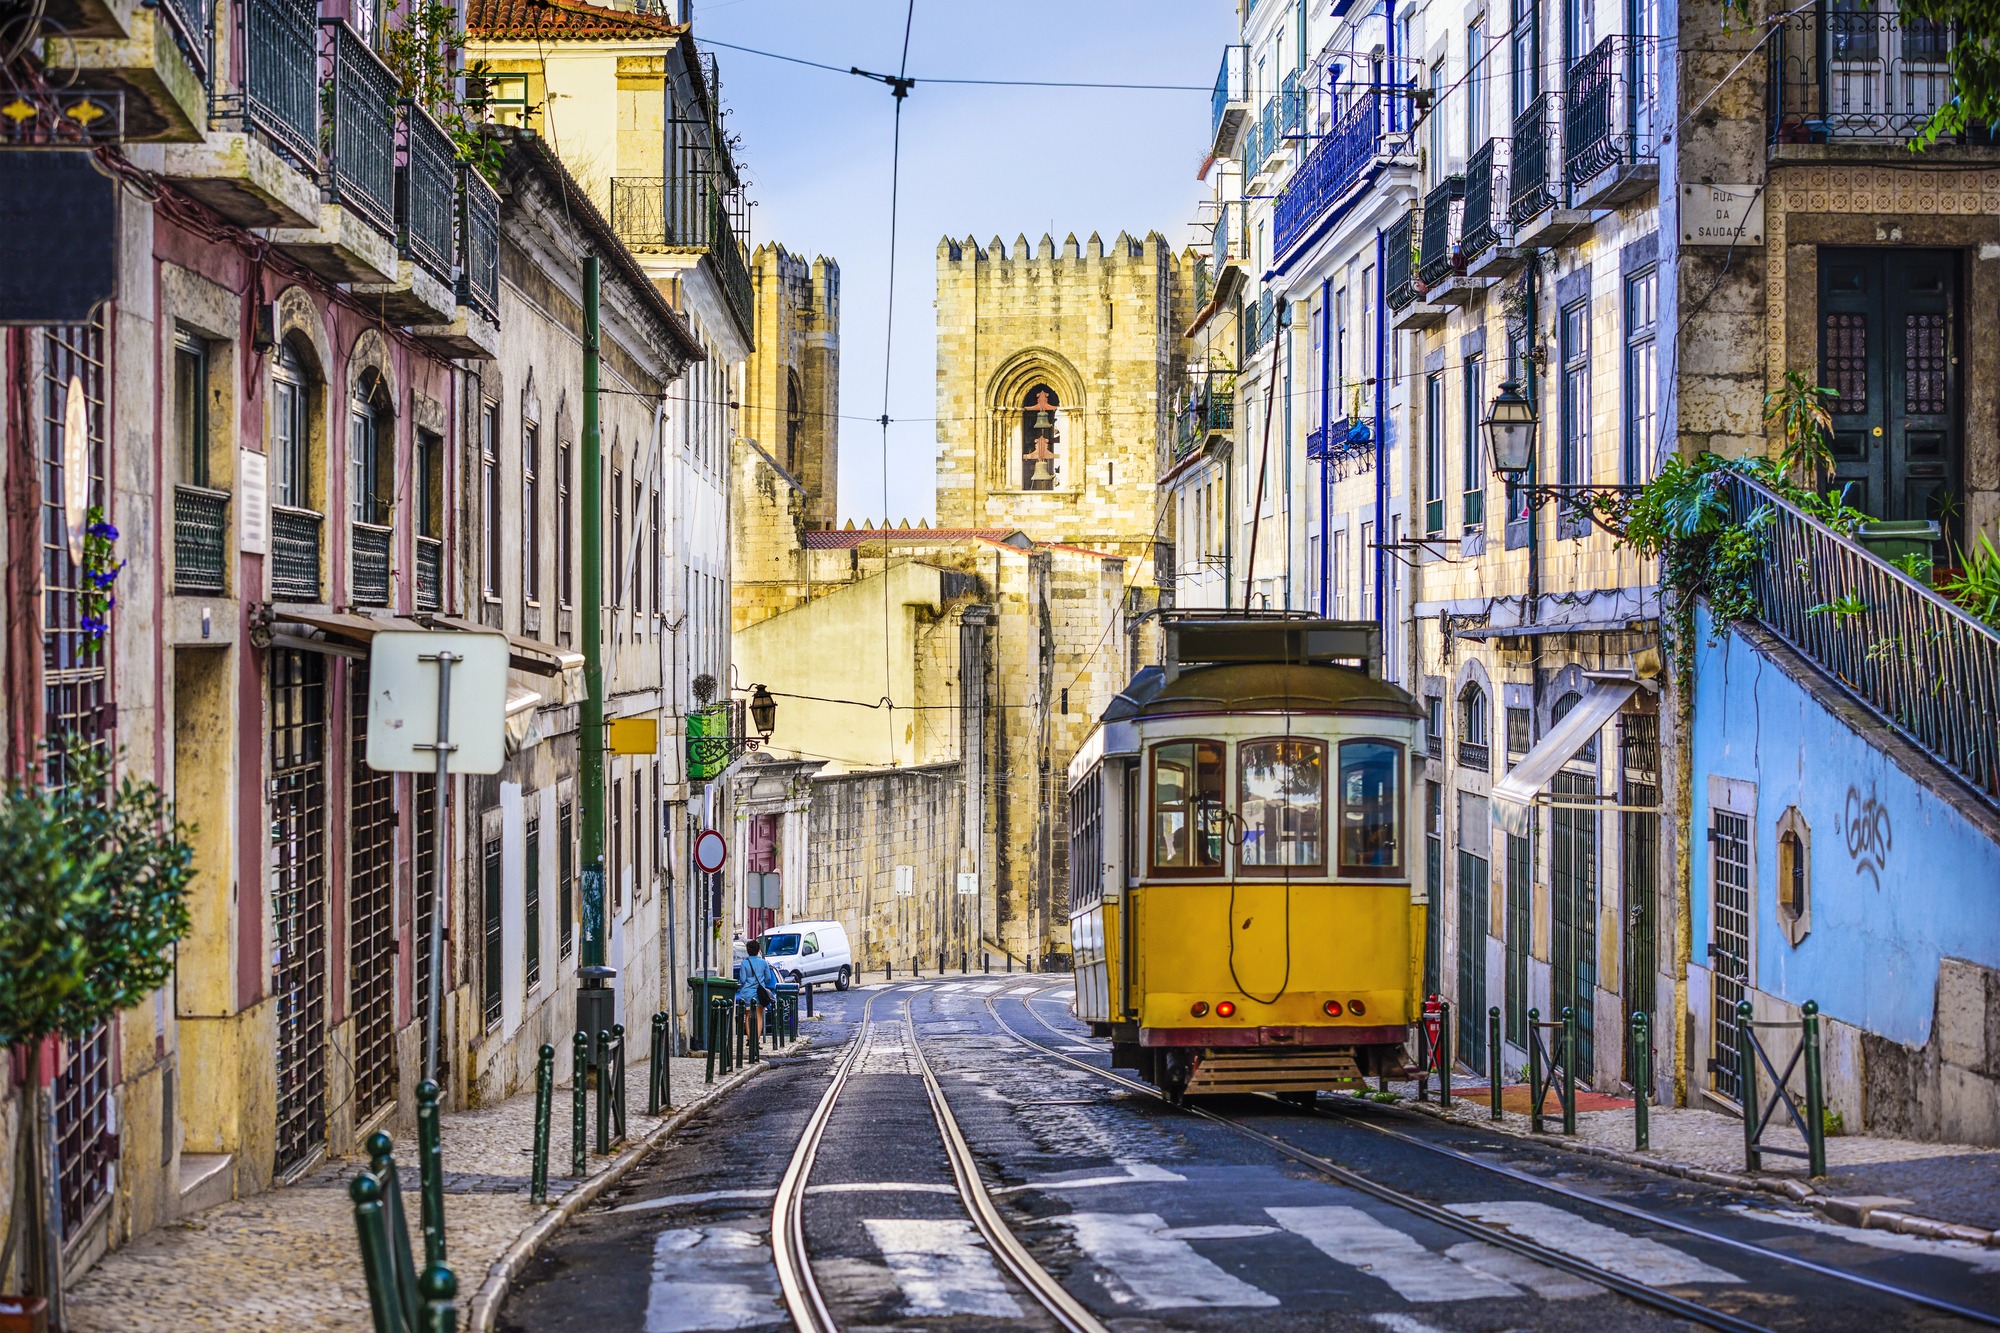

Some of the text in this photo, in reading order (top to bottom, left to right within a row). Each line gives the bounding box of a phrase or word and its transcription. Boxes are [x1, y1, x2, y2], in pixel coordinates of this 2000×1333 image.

[1713, 192, 1733, 202] RUA
[1716, 210, 1730, 219] DA
[1698, 227, 1747, 237] SAUDADE
